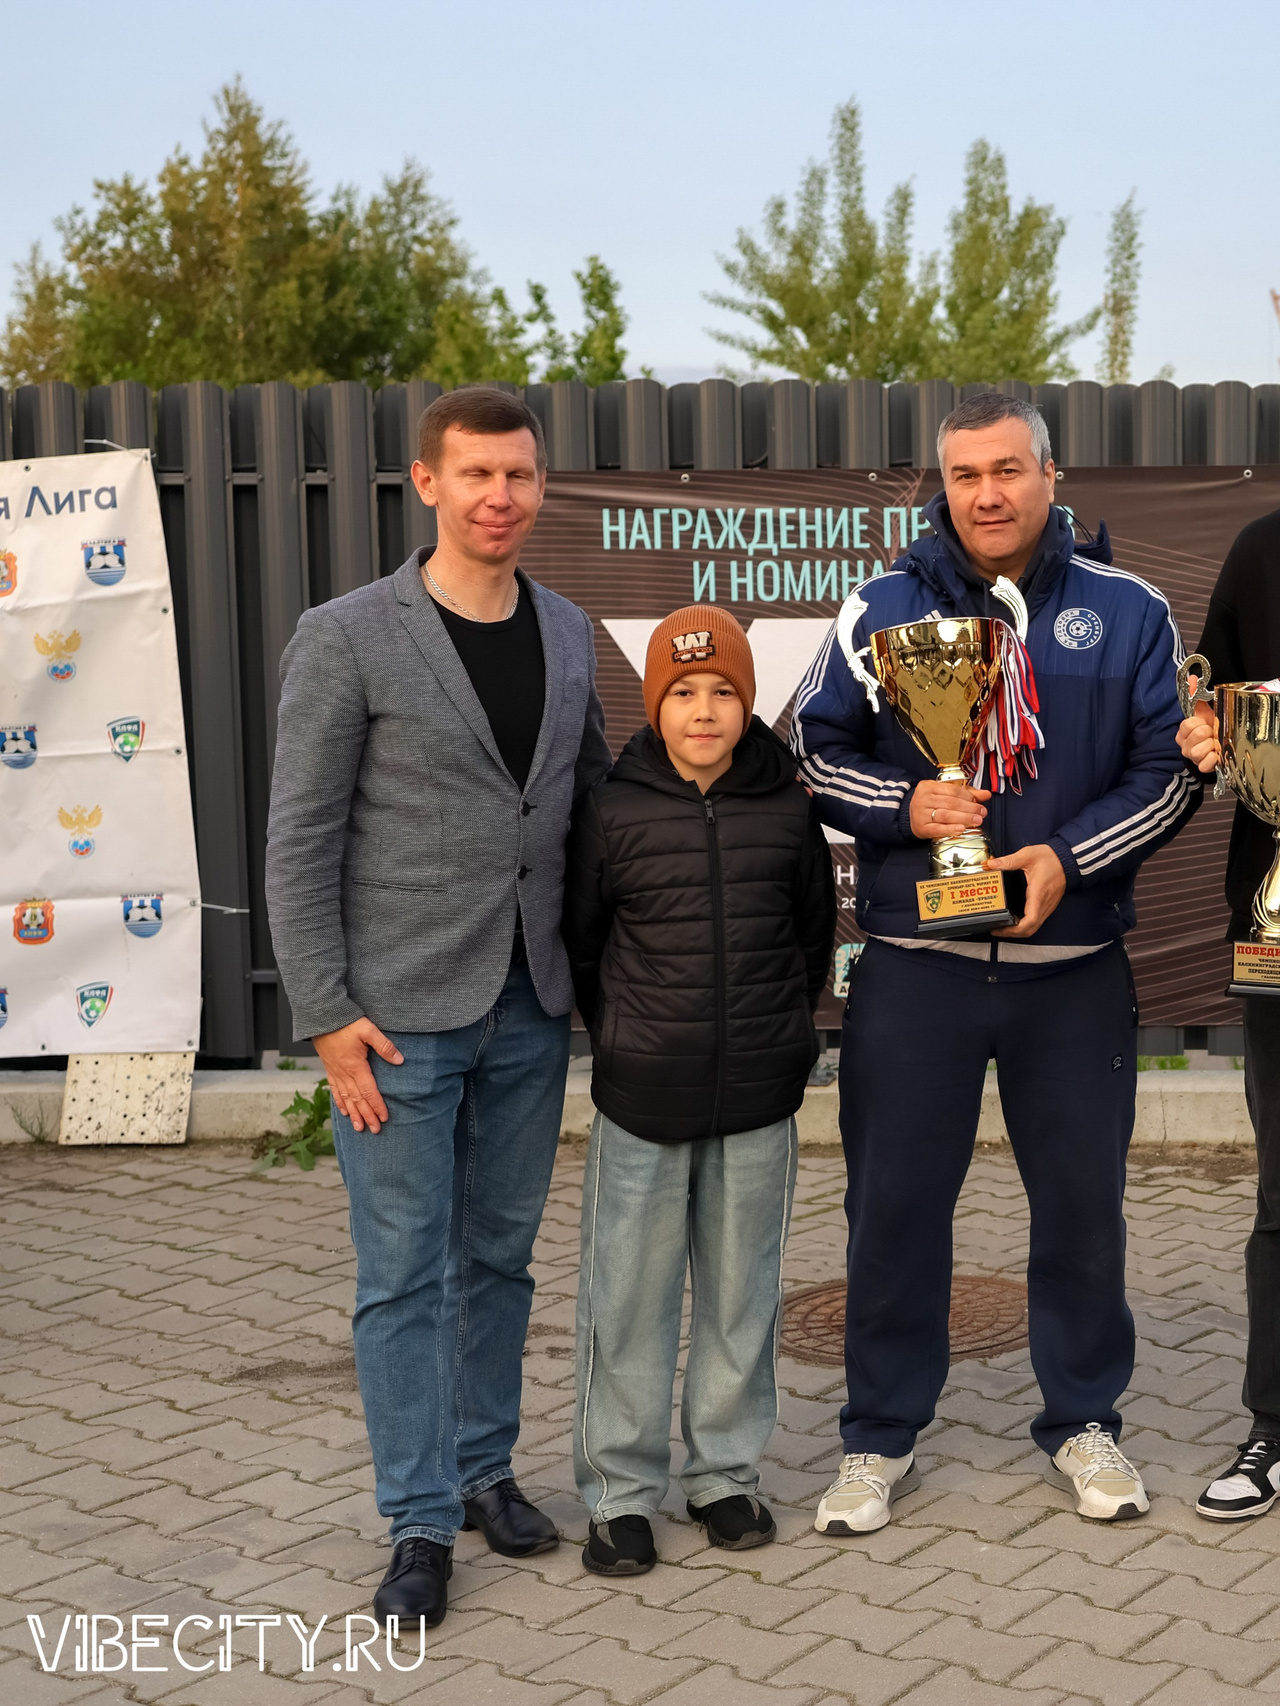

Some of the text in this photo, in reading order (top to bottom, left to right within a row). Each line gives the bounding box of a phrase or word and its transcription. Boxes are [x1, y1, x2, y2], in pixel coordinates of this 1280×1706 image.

[25, 486, 118, 519] Лига
[602, 507, 871, 556] НАГРАЖДЕНИЕ
[693, 559, 897, 602] И НОМИН
